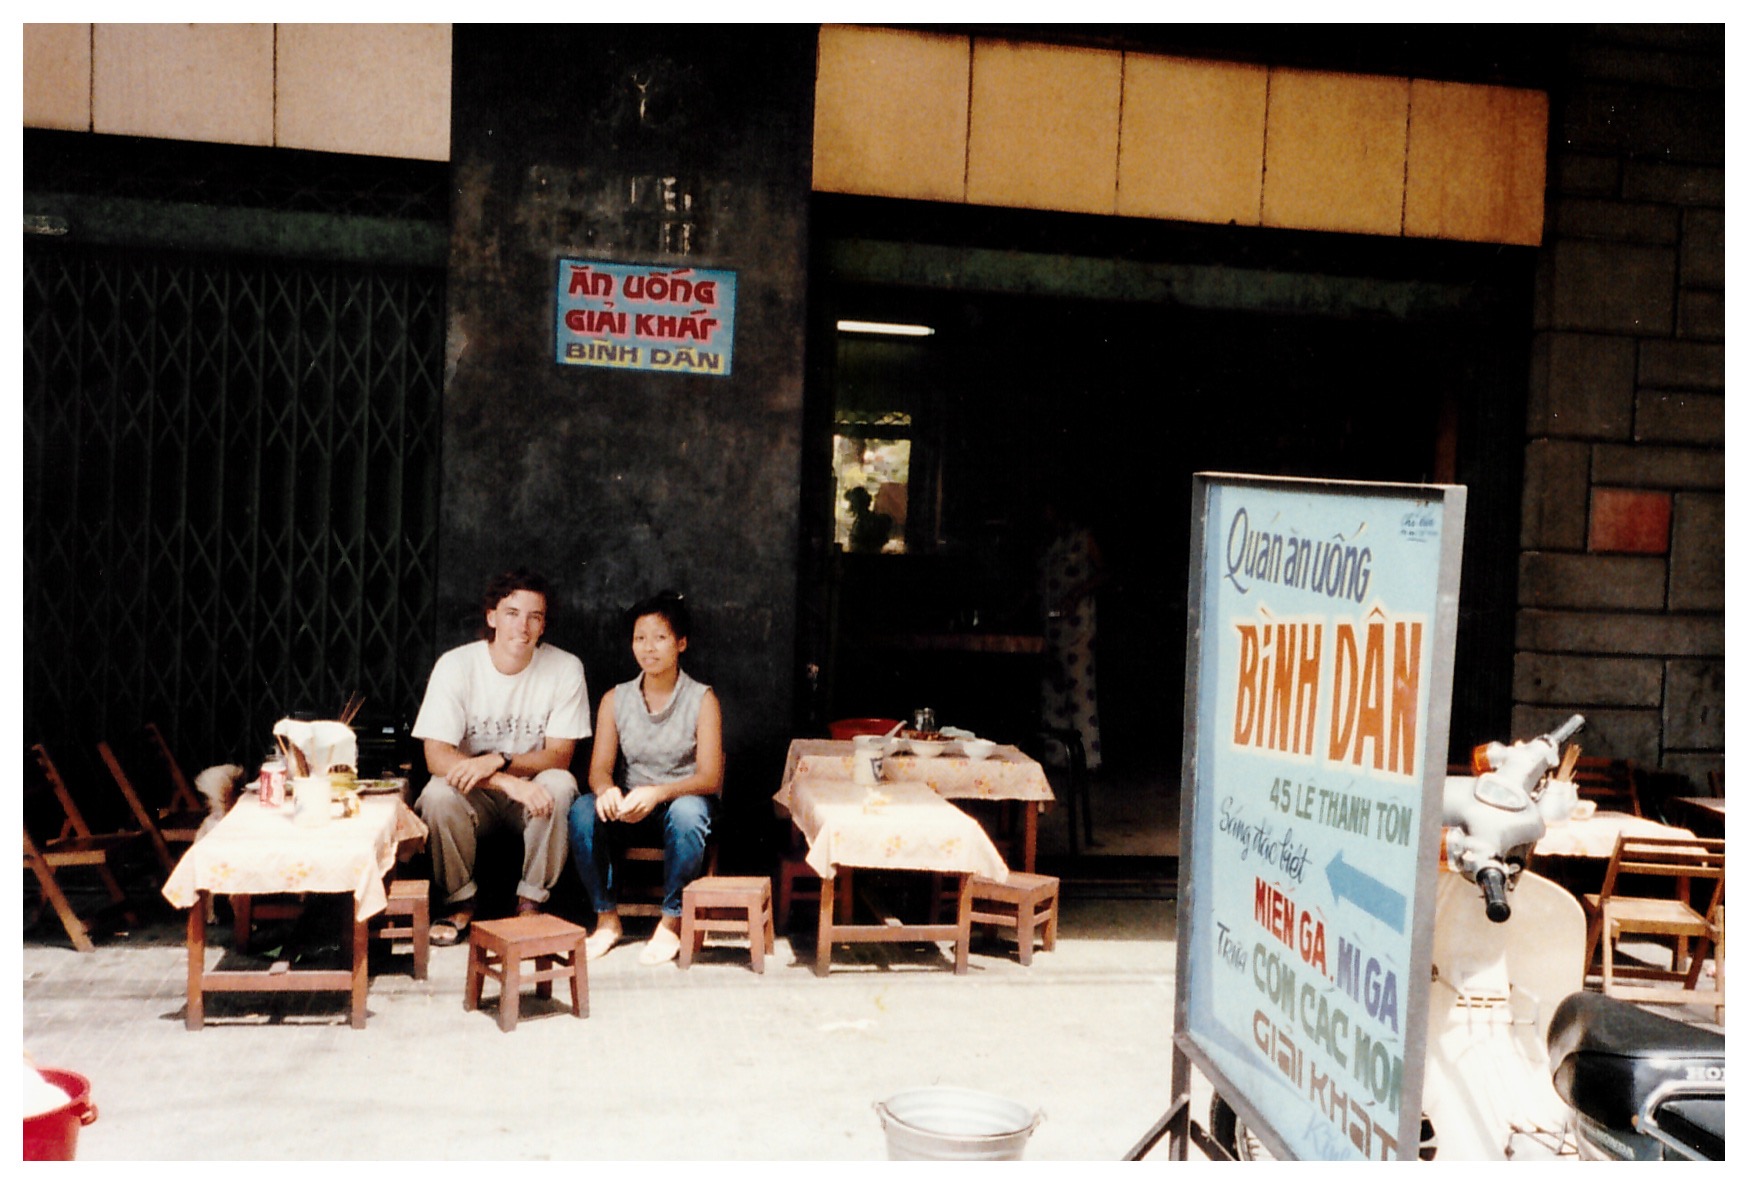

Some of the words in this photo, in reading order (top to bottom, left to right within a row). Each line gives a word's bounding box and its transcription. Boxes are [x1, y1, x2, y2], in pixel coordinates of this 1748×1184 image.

[565, 302, 627, 335] GIẢI
[1233, 606, 1323, 756] BÌNH
[1327, 606, 1423, 777] DÂN
[1269, 777, 1292, 814] 45
[1295, 777, 1316, 820] LÊ
[1375, 796, 1413, 847] TÔN
[1300, 983, 1350, 1070] CÁC
[1363, 953, 1399, 1035] GÀ
